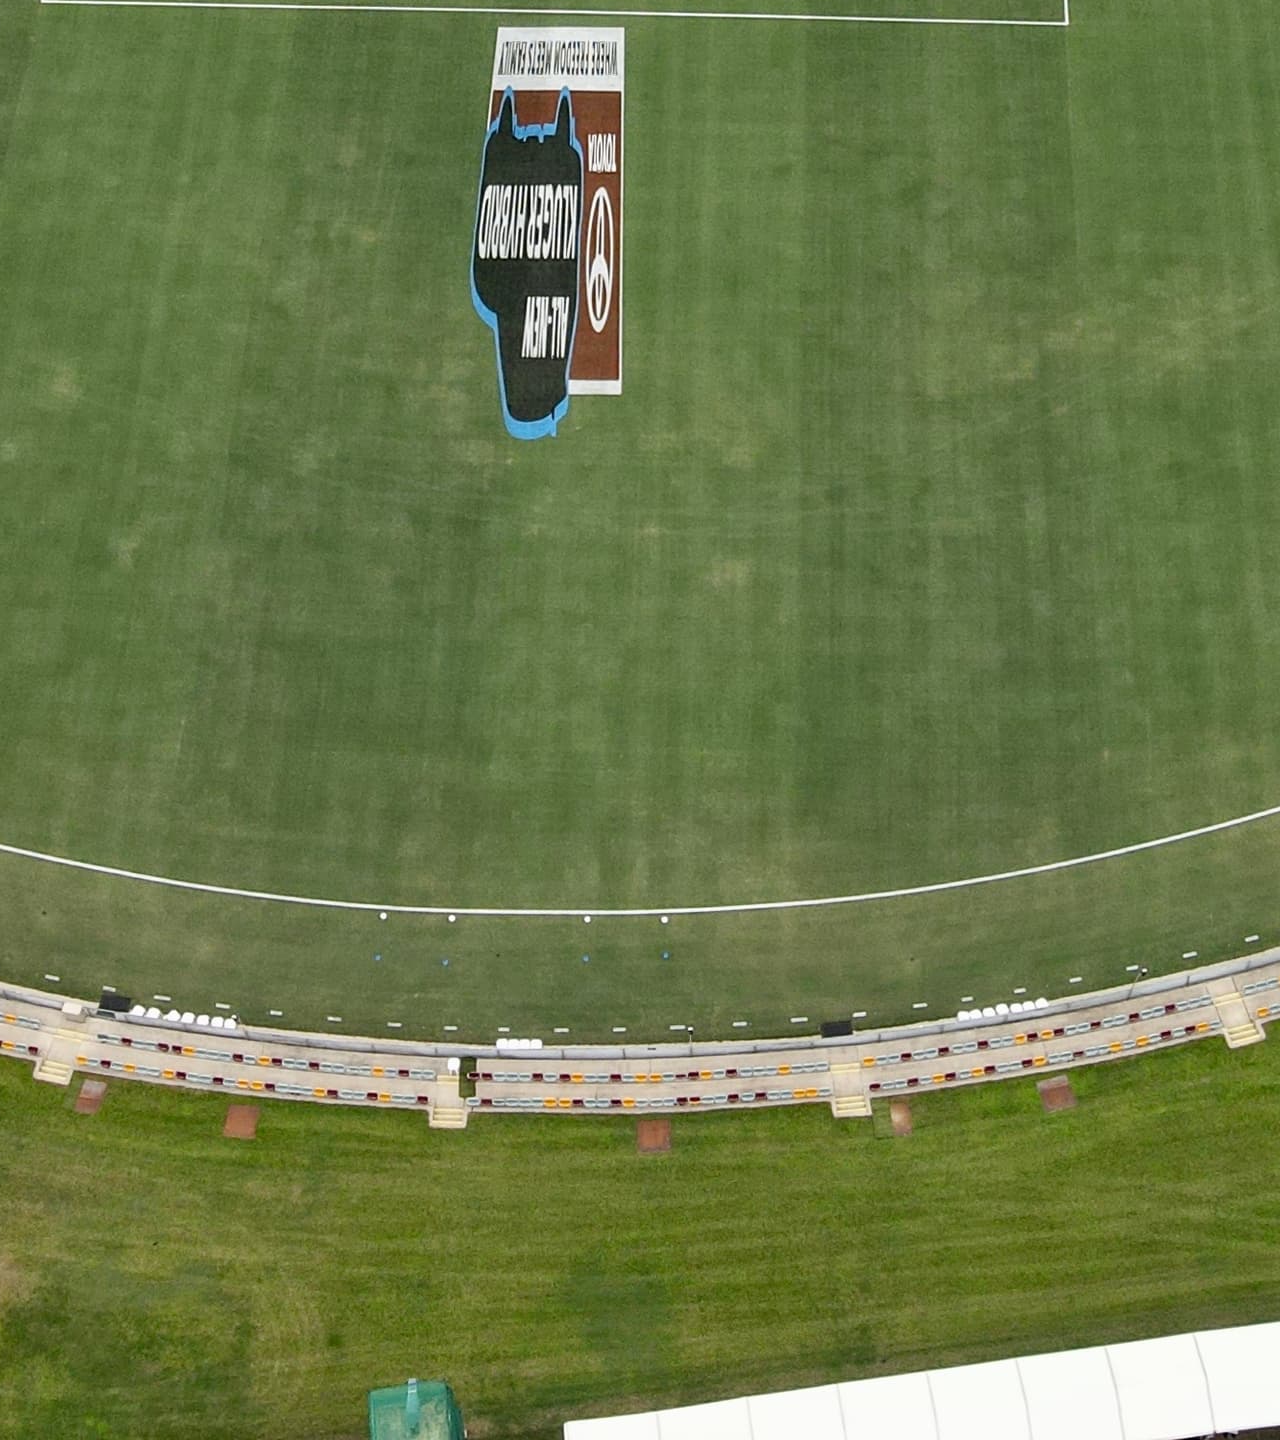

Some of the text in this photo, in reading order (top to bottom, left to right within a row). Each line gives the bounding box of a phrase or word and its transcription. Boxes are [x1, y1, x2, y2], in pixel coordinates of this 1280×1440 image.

[498, 40, 618, 75] WHERE FREEDOM MEETS FAMILY
[588, 134, 616, 173] TOYOTA
[478, 184, 578, 260] KLUGER HYBRID
[521, 296, 570, 359] ALL-NEW
